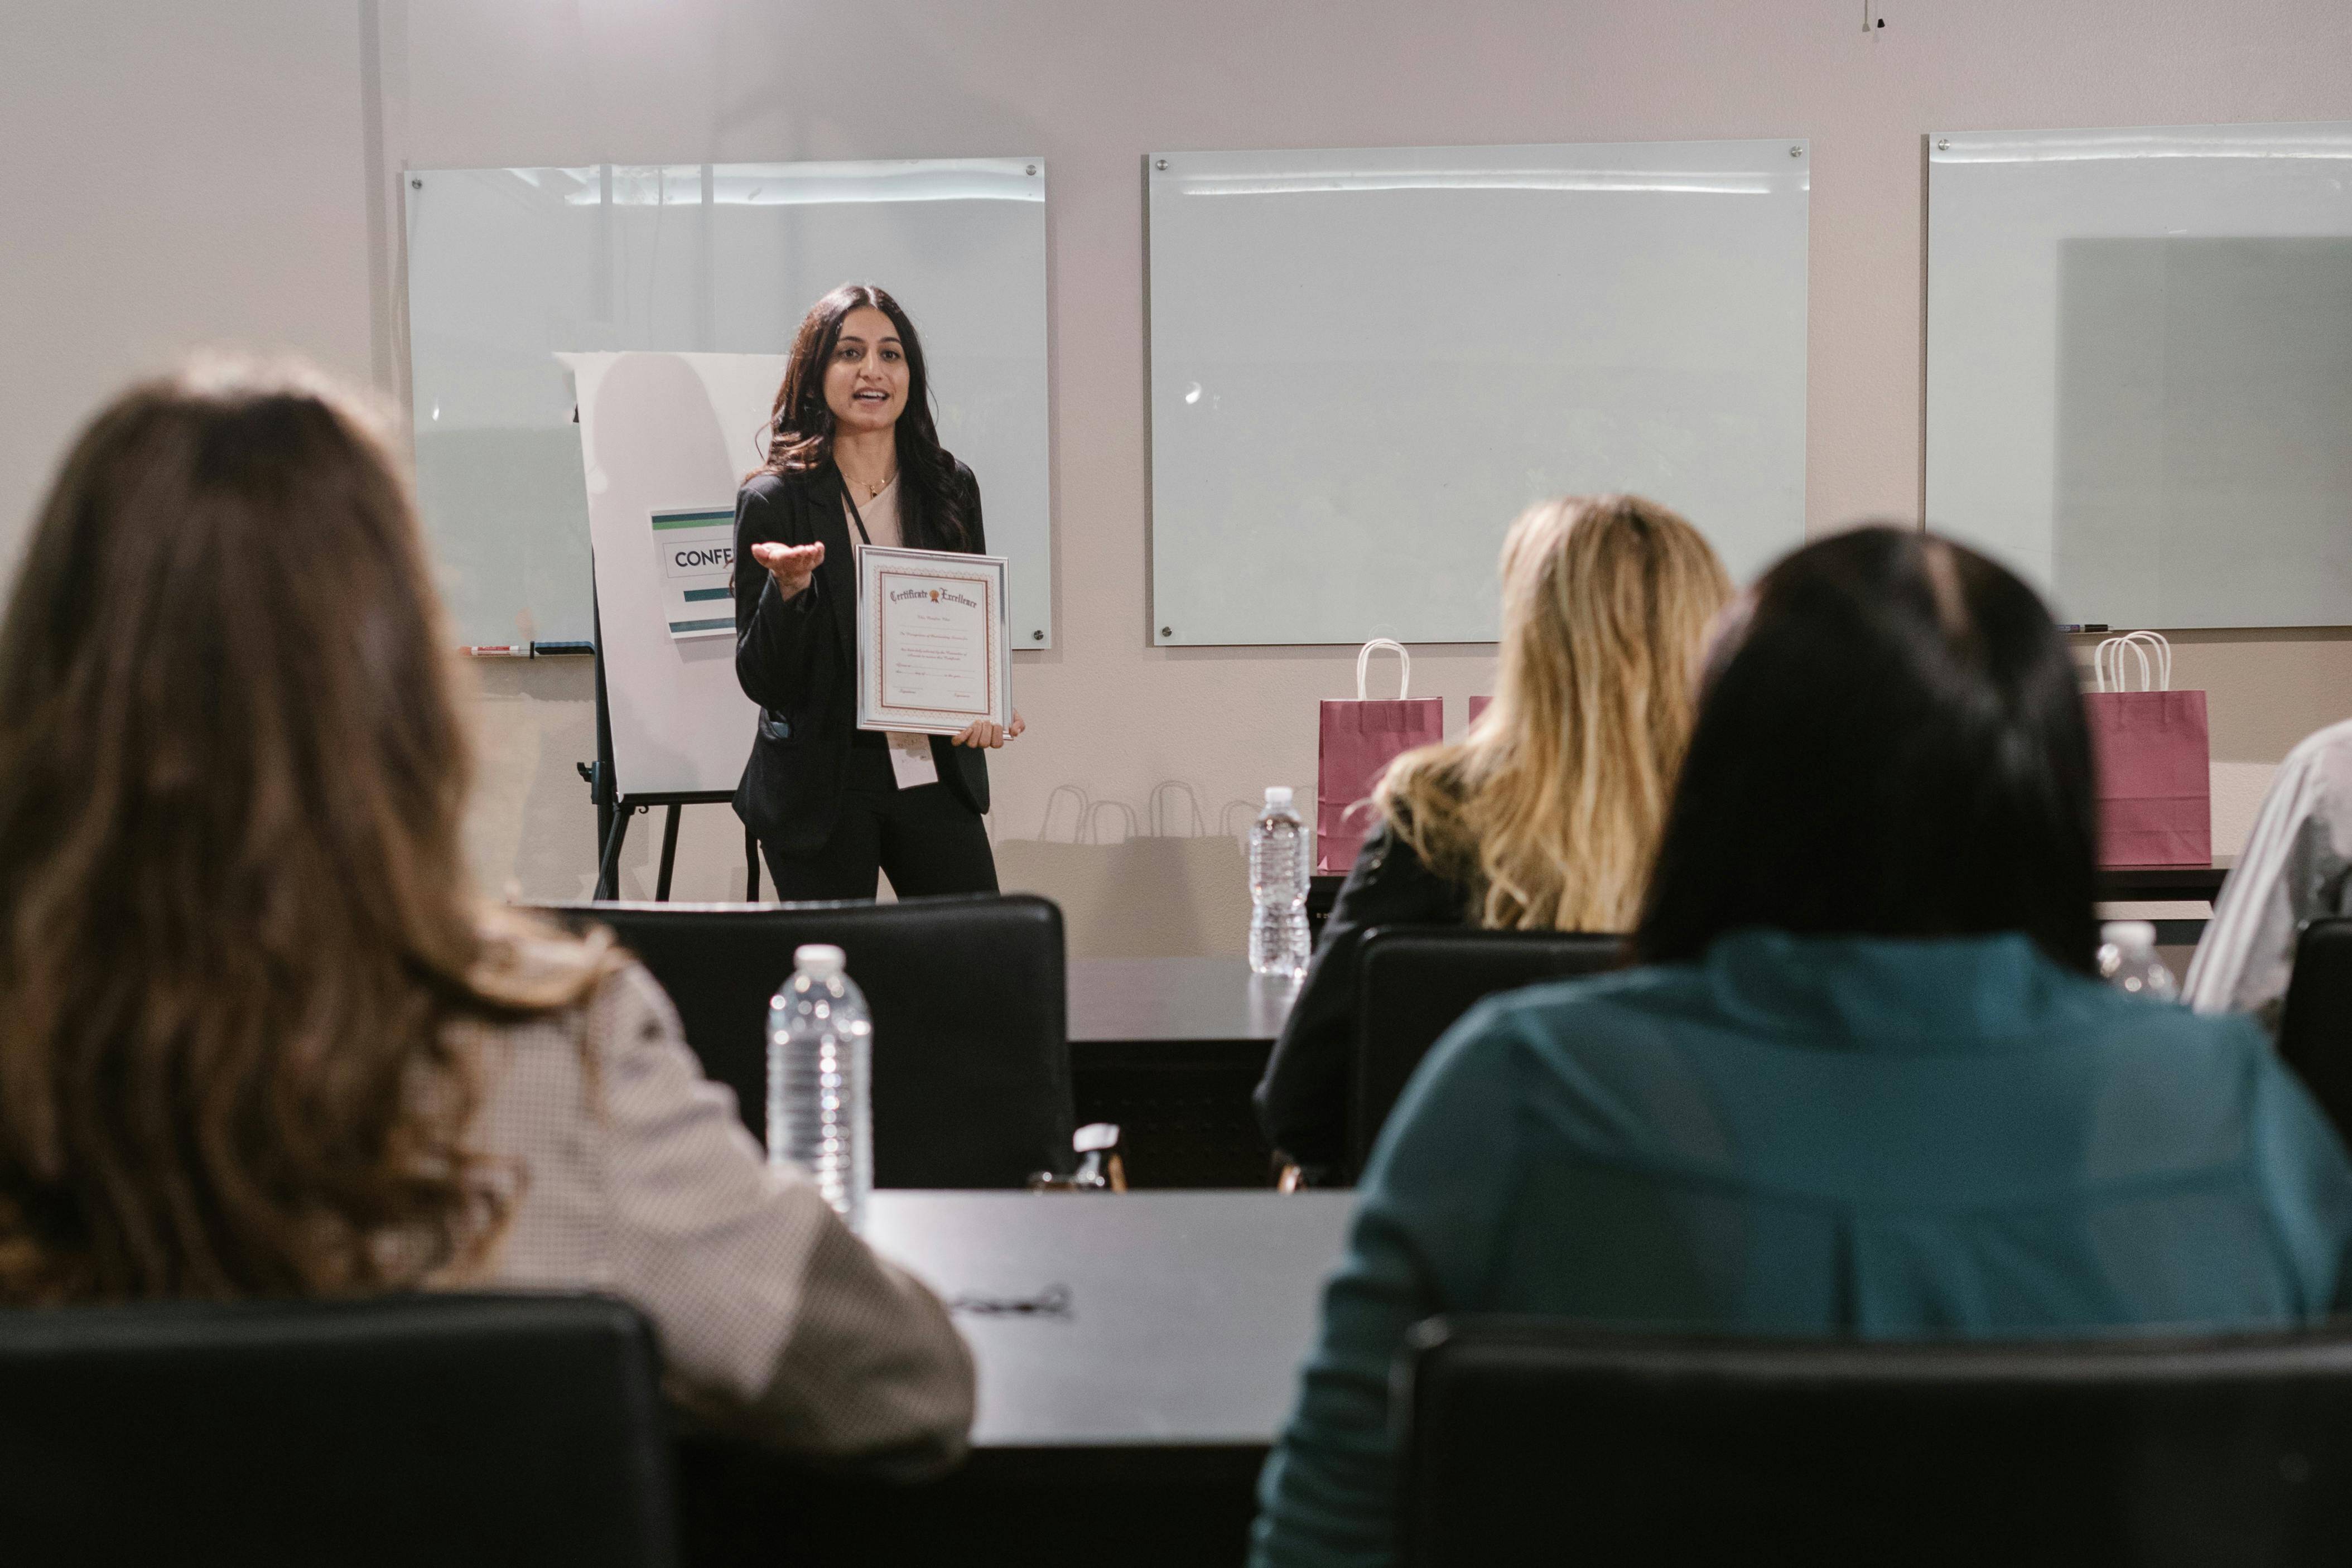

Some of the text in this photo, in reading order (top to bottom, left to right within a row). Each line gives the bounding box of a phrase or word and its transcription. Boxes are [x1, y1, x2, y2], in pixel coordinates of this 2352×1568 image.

[675, 548, 734, 567] CONFE
[890, 587, 977, 609] Certificate Excellence
